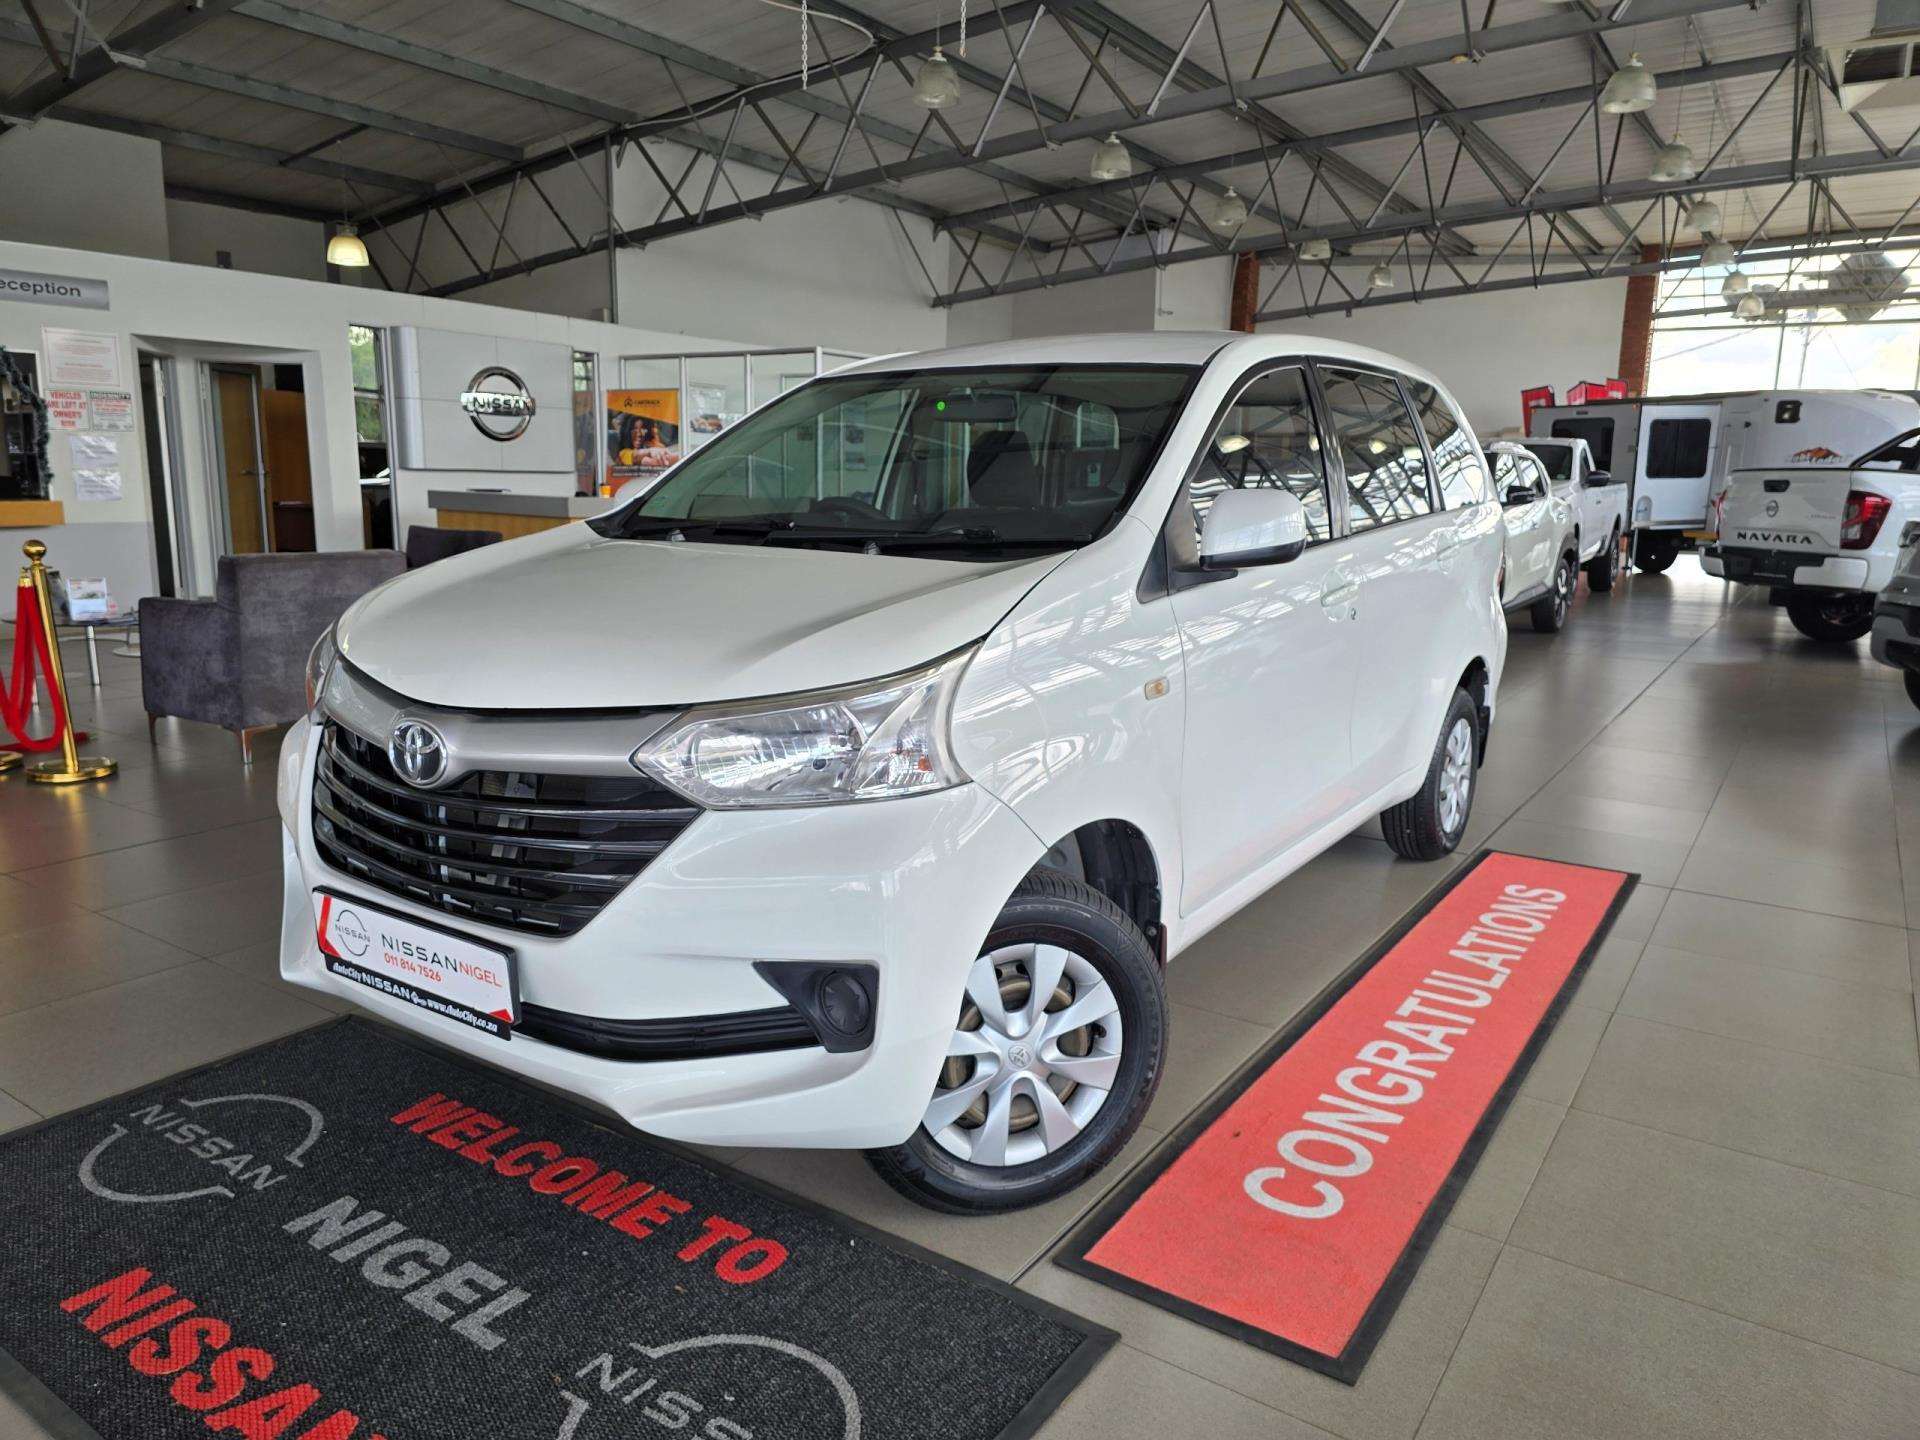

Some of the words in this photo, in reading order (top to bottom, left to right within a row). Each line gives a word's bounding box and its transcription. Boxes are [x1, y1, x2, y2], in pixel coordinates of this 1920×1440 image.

[50, 391, 81, 400] VEHICLES
[62, 401, 77, 409] LEFT
[473, 396, 533, 412] NISSAN
[1737, 531, 1813, 545] NAVARA
[335, 923, 371, 943] NISSAN
[384, 953, 399, 968] 011
[400, 958, 416, 973] 814
[418, 962, 443, 982] 7526
[362, 971, 411, 1000] NISSAN
[1243, 884, 1567, 1220] CONGRATULATIONS
[129, 1103, 288, 1190] NISSAN
[390, 1092, 693, 1239] WELCOME
[676, 1215, 789, 1284] TO
[282, 1195, 532, 1351] NIGEL
